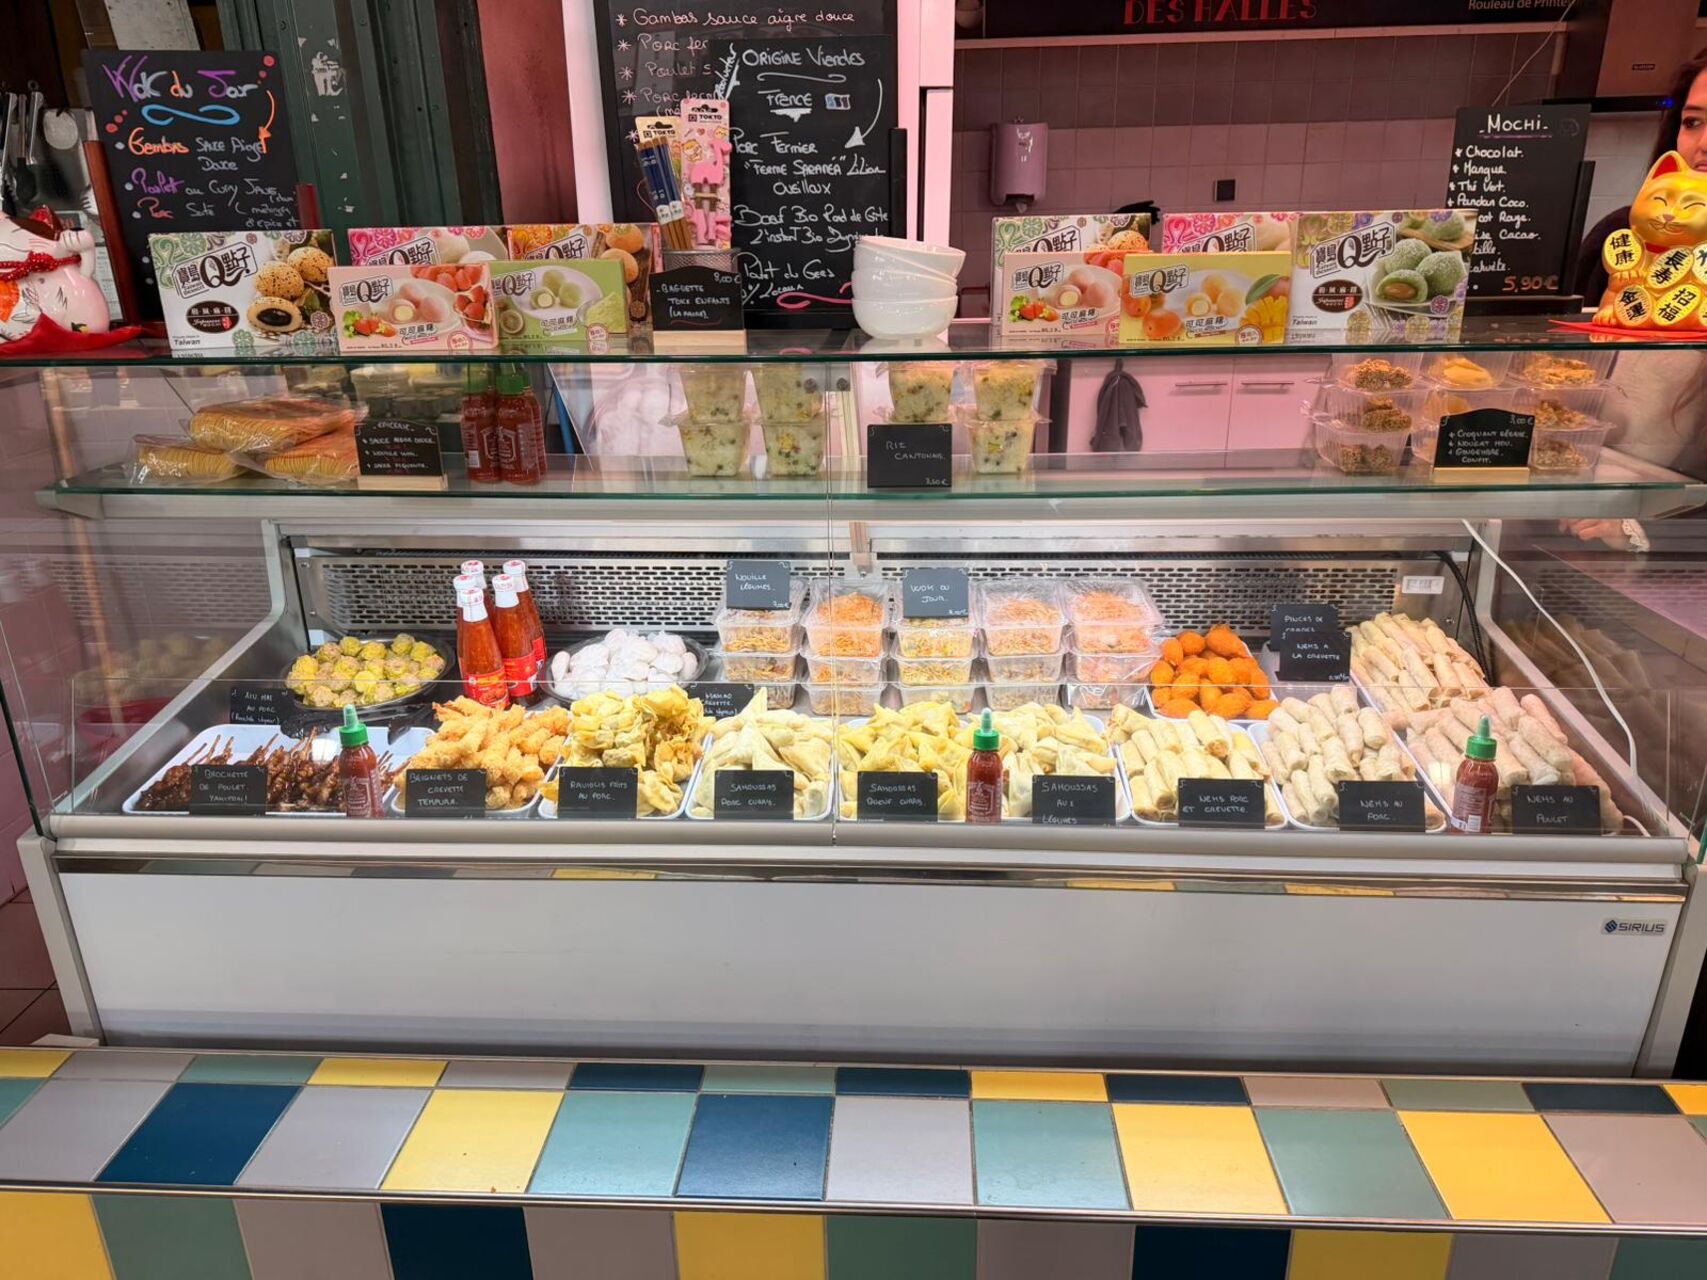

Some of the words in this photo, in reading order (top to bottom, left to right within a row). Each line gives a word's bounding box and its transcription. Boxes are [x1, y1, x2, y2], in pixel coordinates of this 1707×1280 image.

[1468, 0, 1514, 10] Rouleau
[1516, 0, 1531, 8] de
[1124, 0, 1184, 24] DES
[1194, 0, 1317, 22] HALLES
[633, 8, 698, 26] Gambas
[702, 12, 758, 26] sauce
[767, 8, 808, 31] aigre
[815, 12, 856, 22] douce
[1457, 193, 1496, 207] Pandan
[792, 205, 818, 222] Bio
[1610, 233, 1635, 266] 健康
[1620, 289, 1646, 320] 金運
[1659, 288, 1697, 322] 招福
[1292, 318, 1318, 326] Taiwan
[886, 441, 907, 450] RIZ
[457, 773, 468, 781] DE
[1041, 781, 1098, 792] SAMOUSSAS
[578, 792, 588, 800] AU
[1199, 795, 1225, 803] NEMS
[1230, 795, 1249, 803] PORC
[1527, 795, 1555, 803] NEMS
[721, 797, 742, 806] PORC
[1360, 800, 1389, 808] NEMS
[1182, 805, 1195, 813] ET
[1618, 922, 1665, 932] SIRIUS
